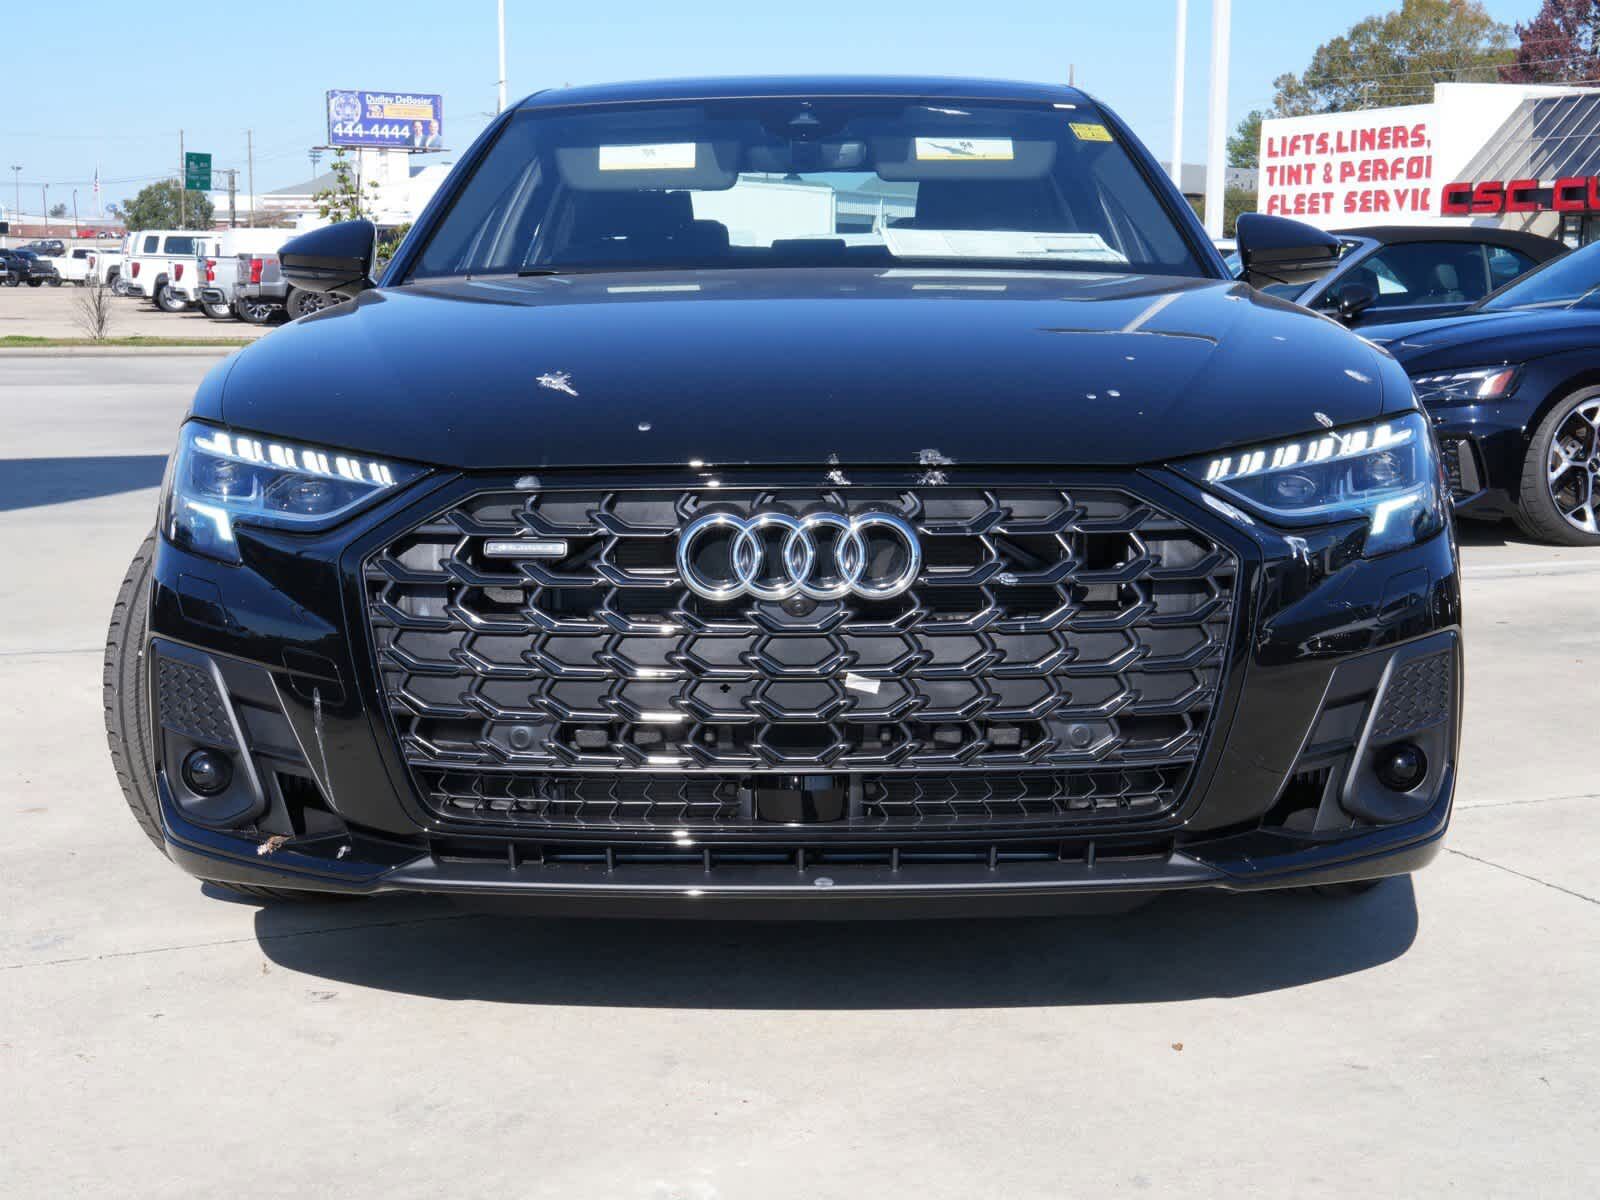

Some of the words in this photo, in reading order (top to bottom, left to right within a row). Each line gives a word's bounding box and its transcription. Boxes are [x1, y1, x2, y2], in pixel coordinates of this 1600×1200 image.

[333, 122, 410, 138] 444-4444
[1266, 163, 1316, 187] TINT
[1323, 162, 1333, 184] &
[1267, 192, 1334, 216] FLEET
[1439, 178, 1541, 215] CSC
